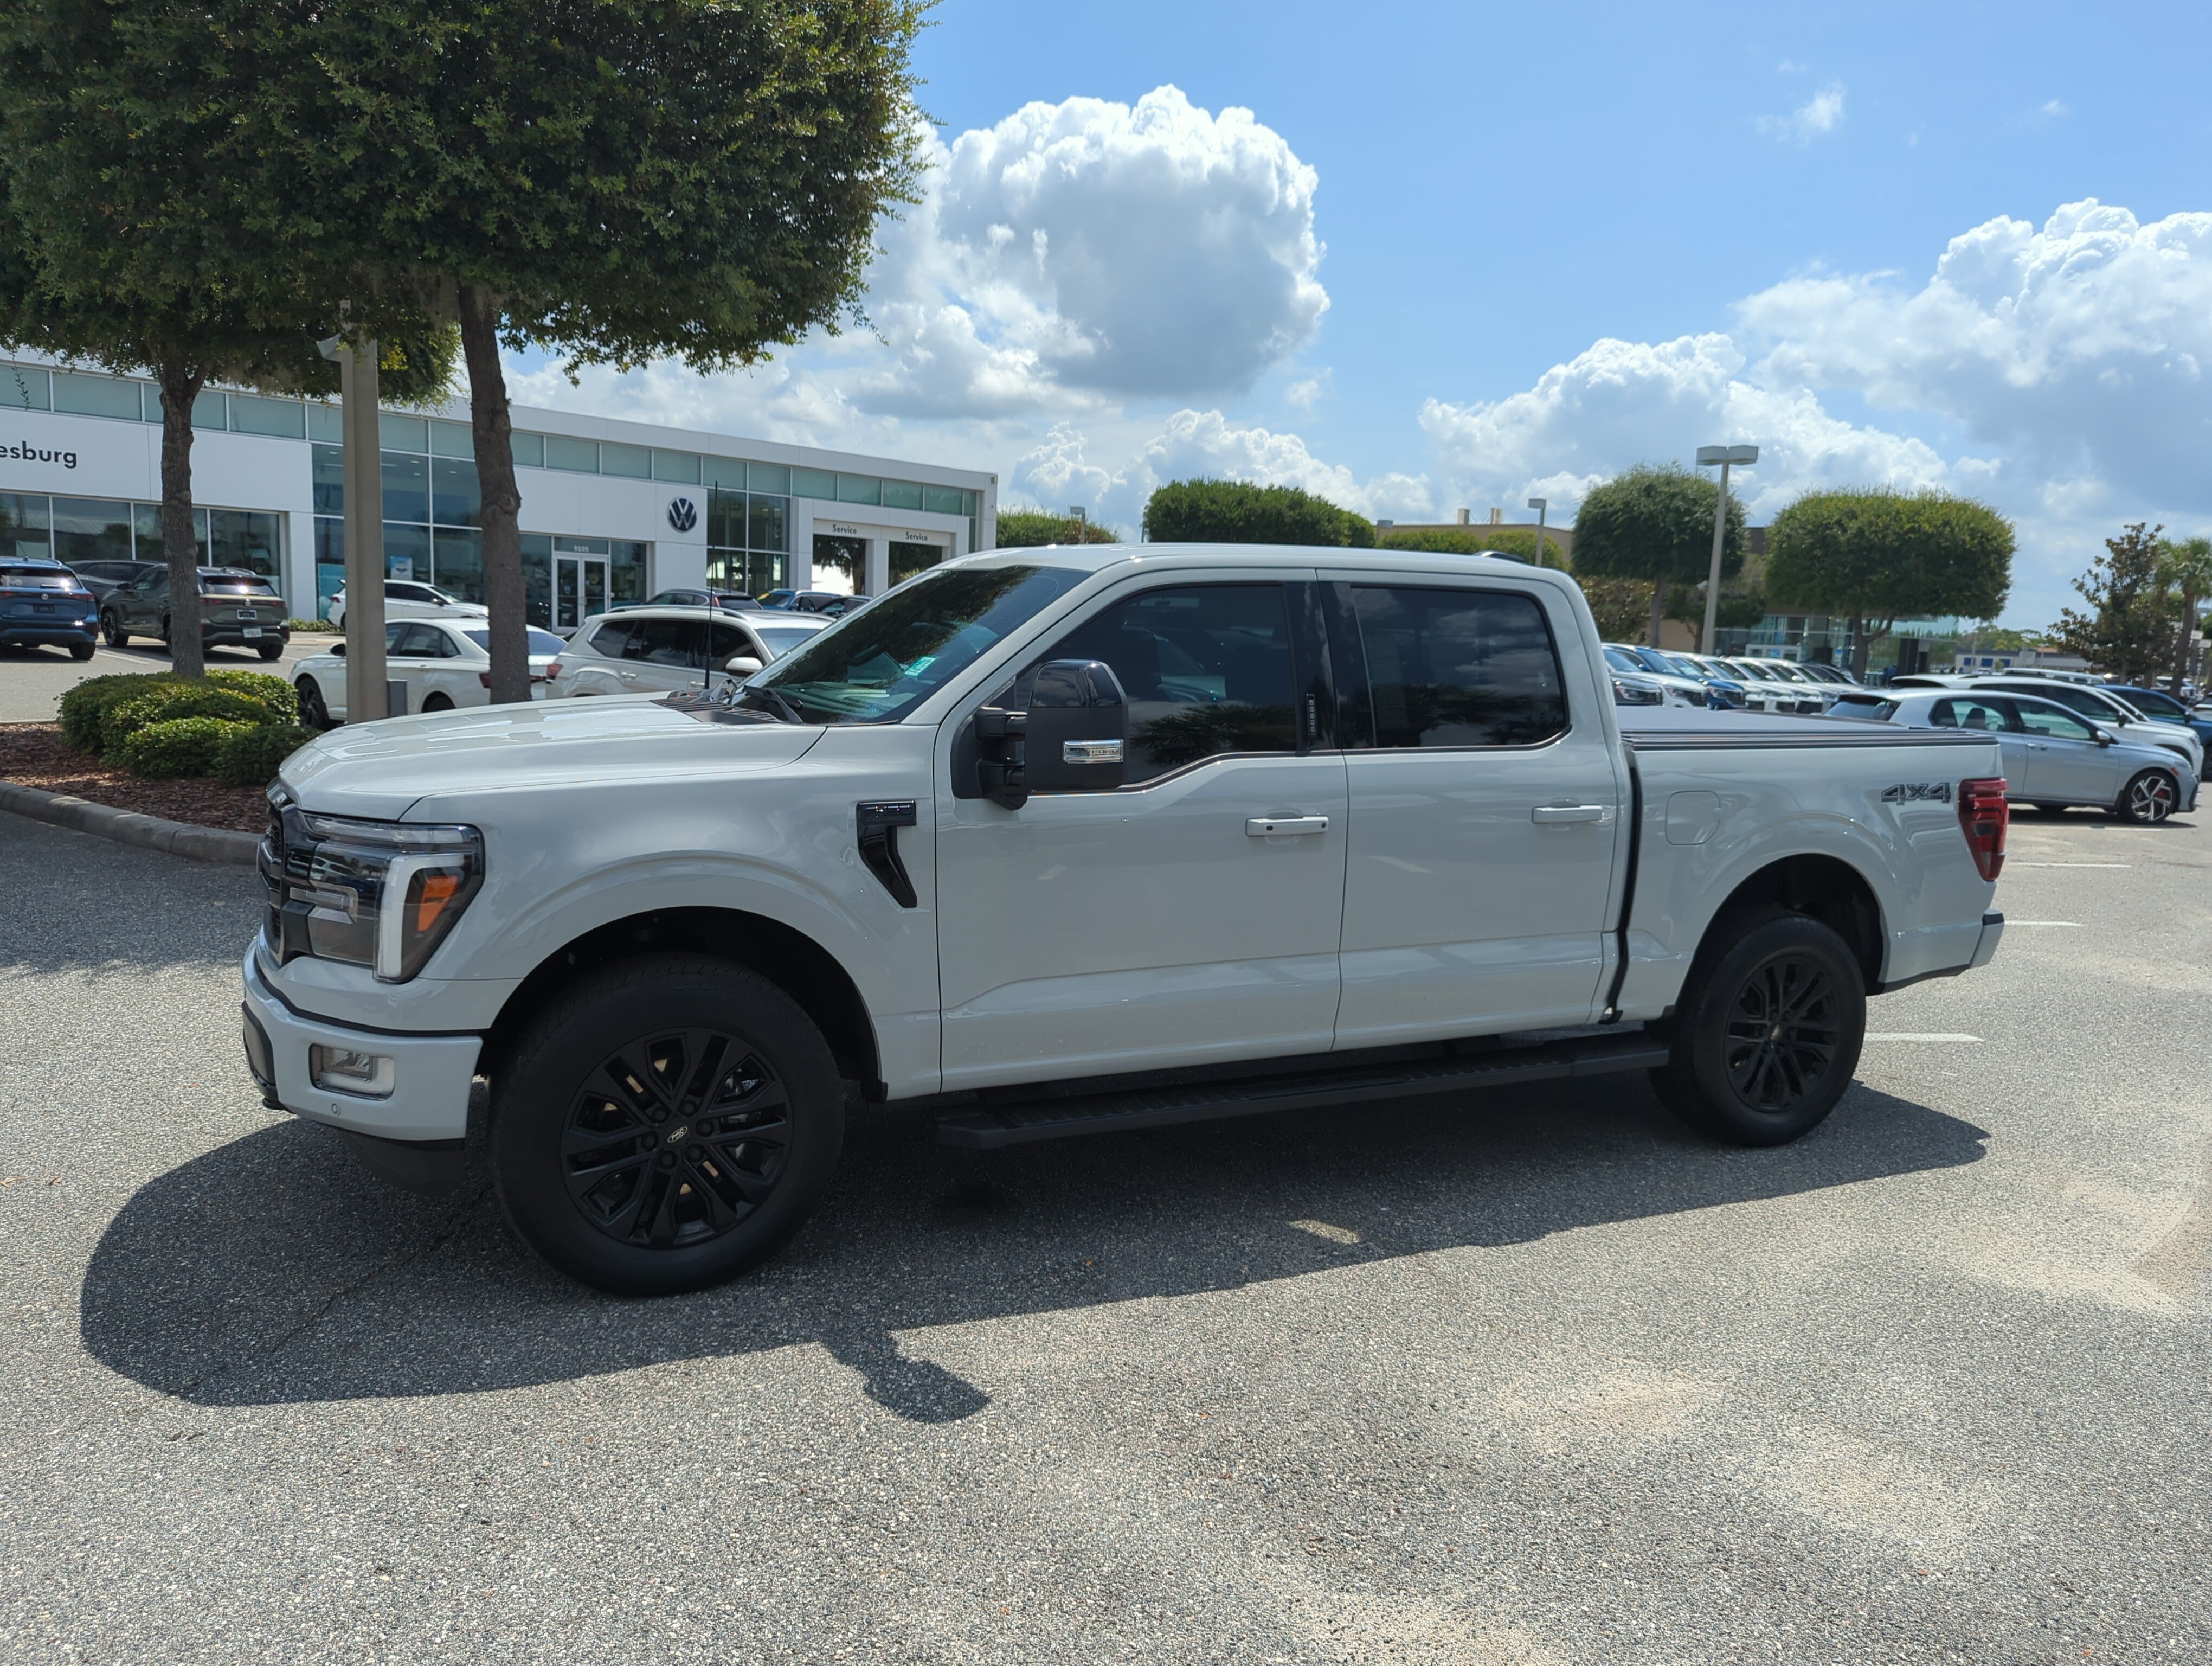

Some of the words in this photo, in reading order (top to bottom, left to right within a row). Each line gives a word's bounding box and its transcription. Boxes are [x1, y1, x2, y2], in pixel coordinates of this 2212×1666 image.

[0, 440, 77, 469] esburg
[832, 524, 857, 535] Service
[905, 531, 928, 542] Service
